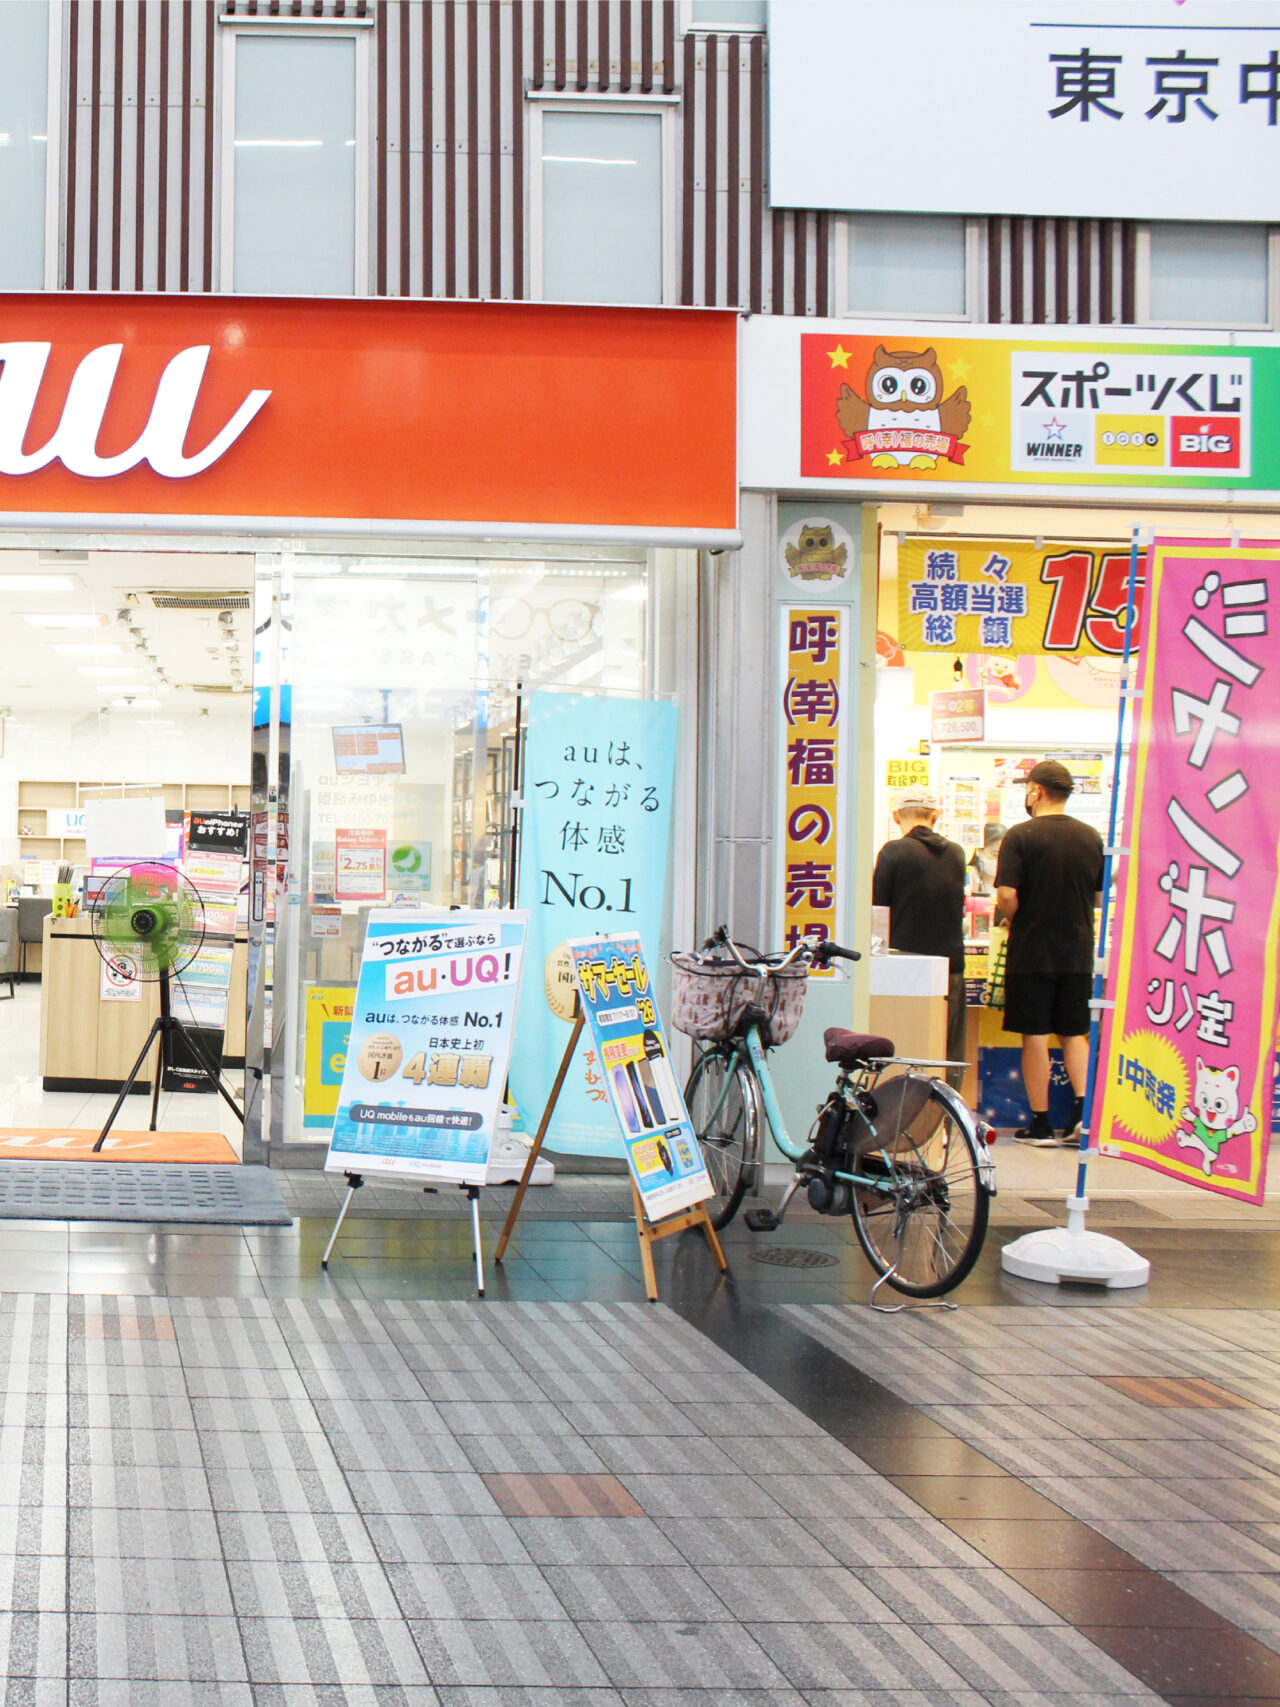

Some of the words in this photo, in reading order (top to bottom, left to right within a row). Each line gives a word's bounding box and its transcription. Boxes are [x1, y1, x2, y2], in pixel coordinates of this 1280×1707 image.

[1020, 361, 1243, 412] スポーツくじ
[1026, 442, 1083, 458] WINNER
[1101, 430, 1159, 447] toto
[927, 552, 1010, 582] 続々
[911, 583, 1025, 614] 高額当選
[925, 615, 1010, 644] 総額
[564, 740, 642, 770] auは、
[888, 760, 926, 773] BIG
[535, 778, 660, 812] つながる
[197, 825, 240, 838] おすすめ!
[560, 820, 626, 855] 体感
[540, 869, 637, 913] No.1
[577, 955, 649, 1003] サマーセール
[365, 1011, 460, 1027] auは、つながる体感
[464, 1011, 503, 1028] No.1
[428, 1036, 485, 1051] 日本史上初
[360, 1109, 375, 1119] UQ
